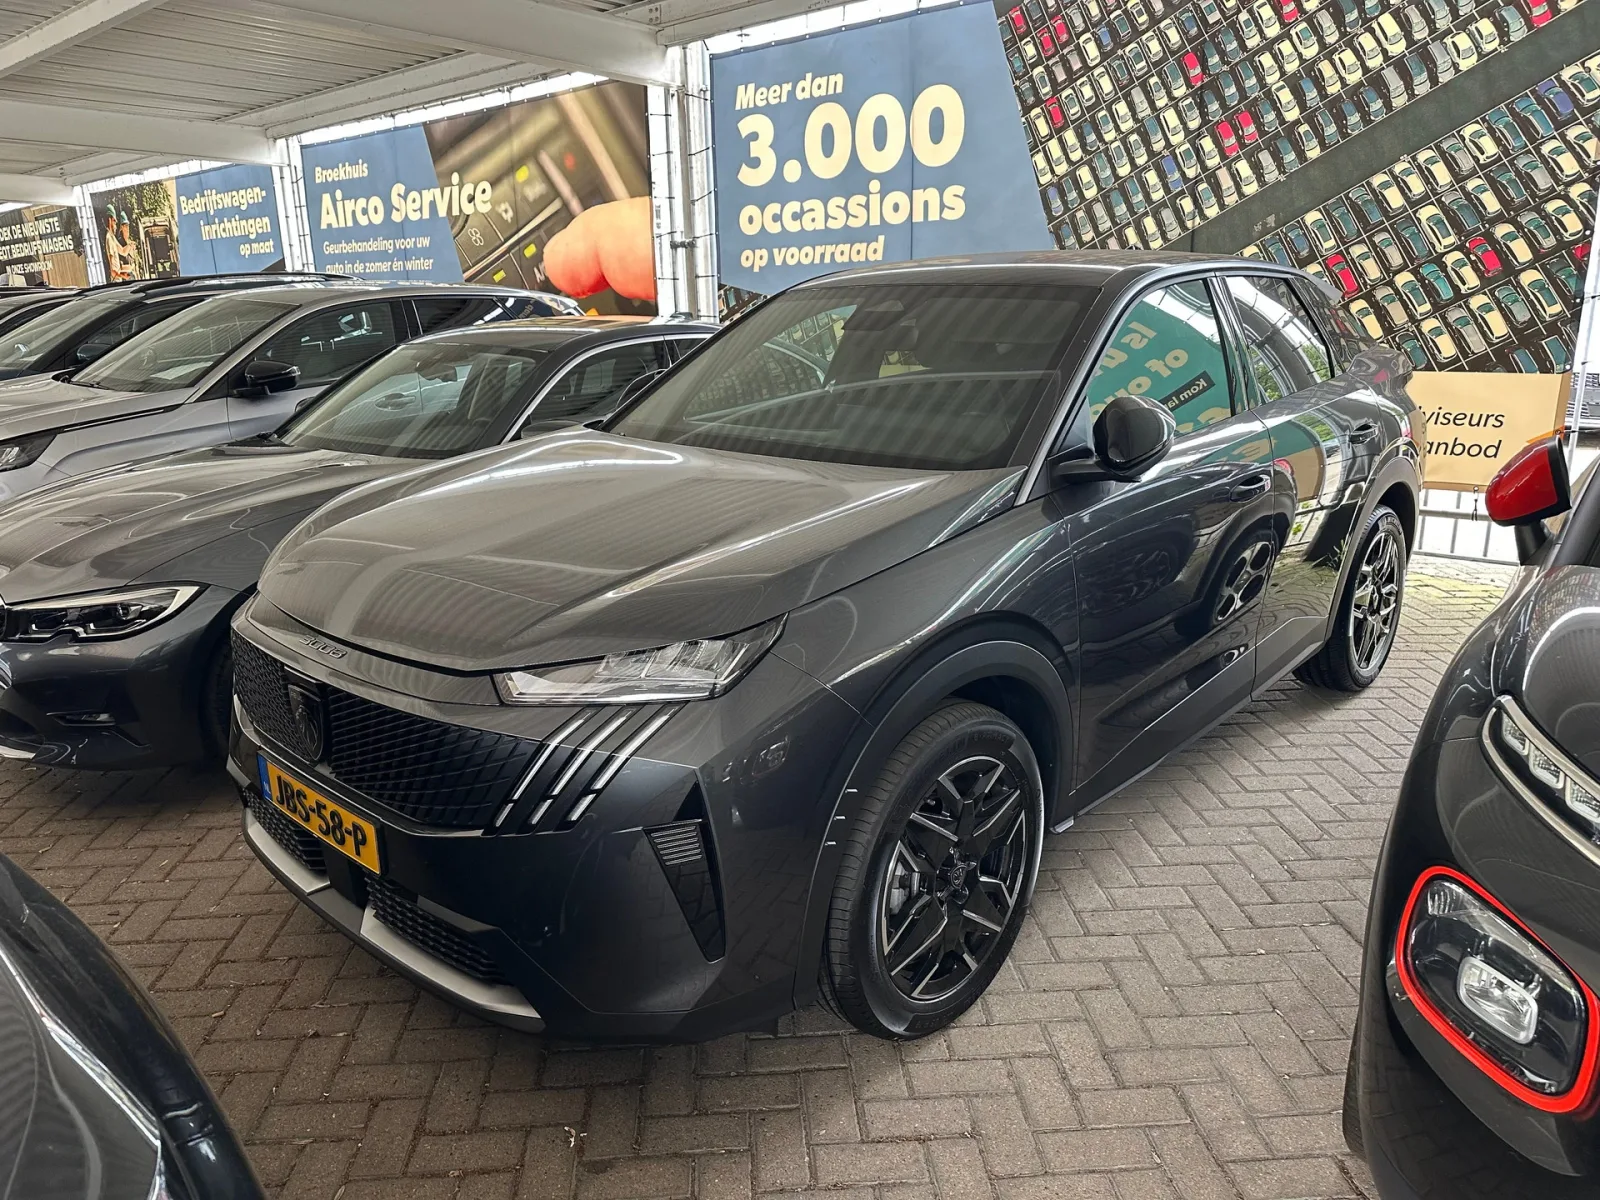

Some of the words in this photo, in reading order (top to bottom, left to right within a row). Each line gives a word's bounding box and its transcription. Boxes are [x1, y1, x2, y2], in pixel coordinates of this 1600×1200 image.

[735, 82, 792, 110] Meer
[795, 72, 844, 100] dan
[736, 83, 965, 187] 3.000
[315, 159, 369, 184] Broekhuis
[179, 186, 267, 216] Bedrijfswagen-
[320, 189, 385, 230] Airco
[390, 171, 493, 223] Service
[738, 179, 967, 236] occassions
[11, 224, 23, 239] DE
[21, 216, 61, 238] NIEUWSTE
[200, 214, 271, 240] inrichtingen
[239, 243, 251, 259] op
[251, 238, 275, 255] maat
[323, 236, 394, 255] Geurbehandeling
[394, 237, 416, 249] voor
[416, 236, 431, 247] uw
[740, 247, 769, 273] op
[772, 235, 885, 267] voorraad
[325, 262, 344, 274] auto
[344, 261, 353, 273] in
[353, 260, 365, 273] de
[365, 260, 391, 273] zomer
[391, 257, 404, 271] én
[404, 256, 434, 270] winter
[1418, 405, 1506, 429] viseurs
[298, 634, 348, 659] 3008
[275, 774, 368, 858] JBS-58-P
